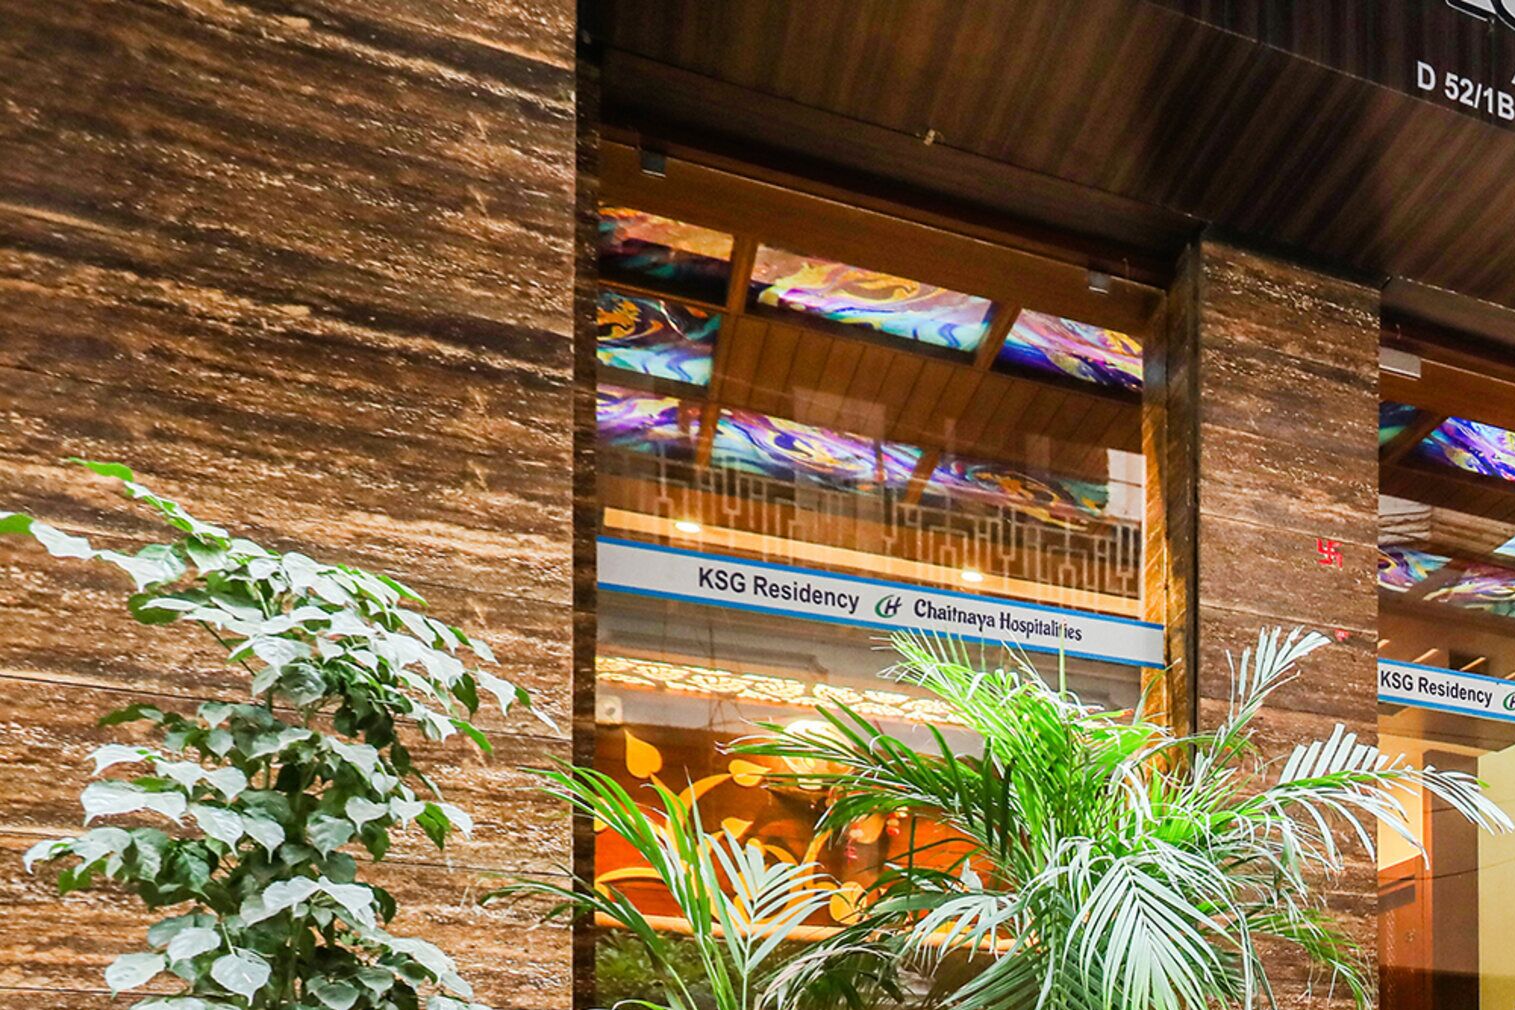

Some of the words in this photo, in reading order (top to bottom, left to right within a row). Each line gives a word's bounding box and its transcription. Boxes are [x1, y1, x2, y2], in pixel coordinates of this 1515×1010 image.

[1417, 61, 1436, 91] D
[1445, 75, 1515, 121] 52/1B
[699, 567, 745, 593] KSG
[753, 576, 860, 614] Residency
[914, 598, 995, 632] Chaitnaya
[1380, 670, 1413, 692] KSG
[1418, 676, 1493, 708] Residency
